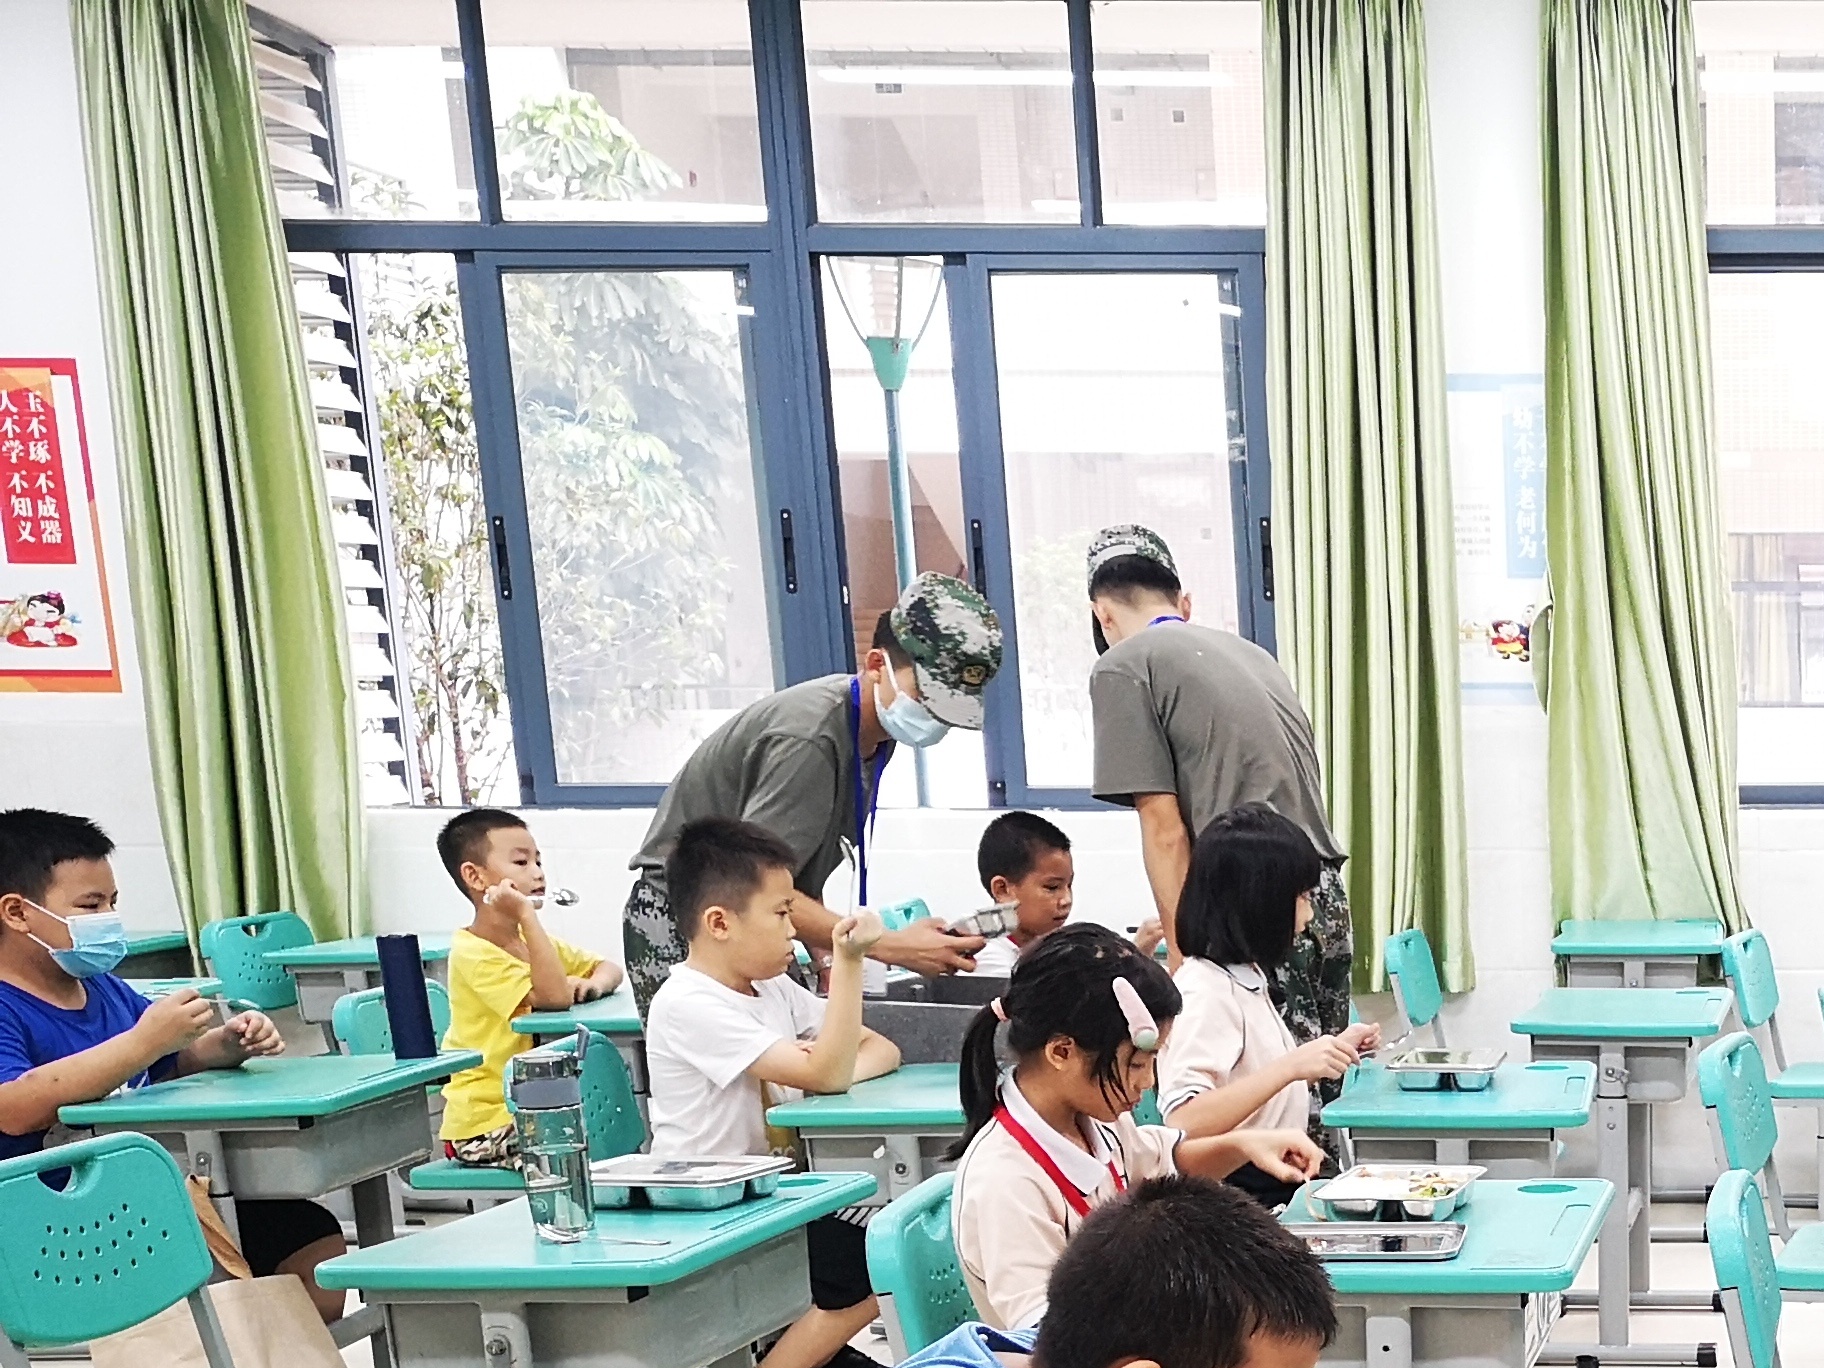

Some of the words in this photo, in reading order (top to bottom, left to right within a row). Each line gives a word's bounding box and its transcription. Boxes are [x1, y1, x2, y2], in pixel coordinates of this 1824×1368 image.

[0, 389, 37, 544] 人不学不知义
[22, 390, 63, 545] 玉不琢不成器
[1512, 404, 1538, 560] 幼不学老何为
